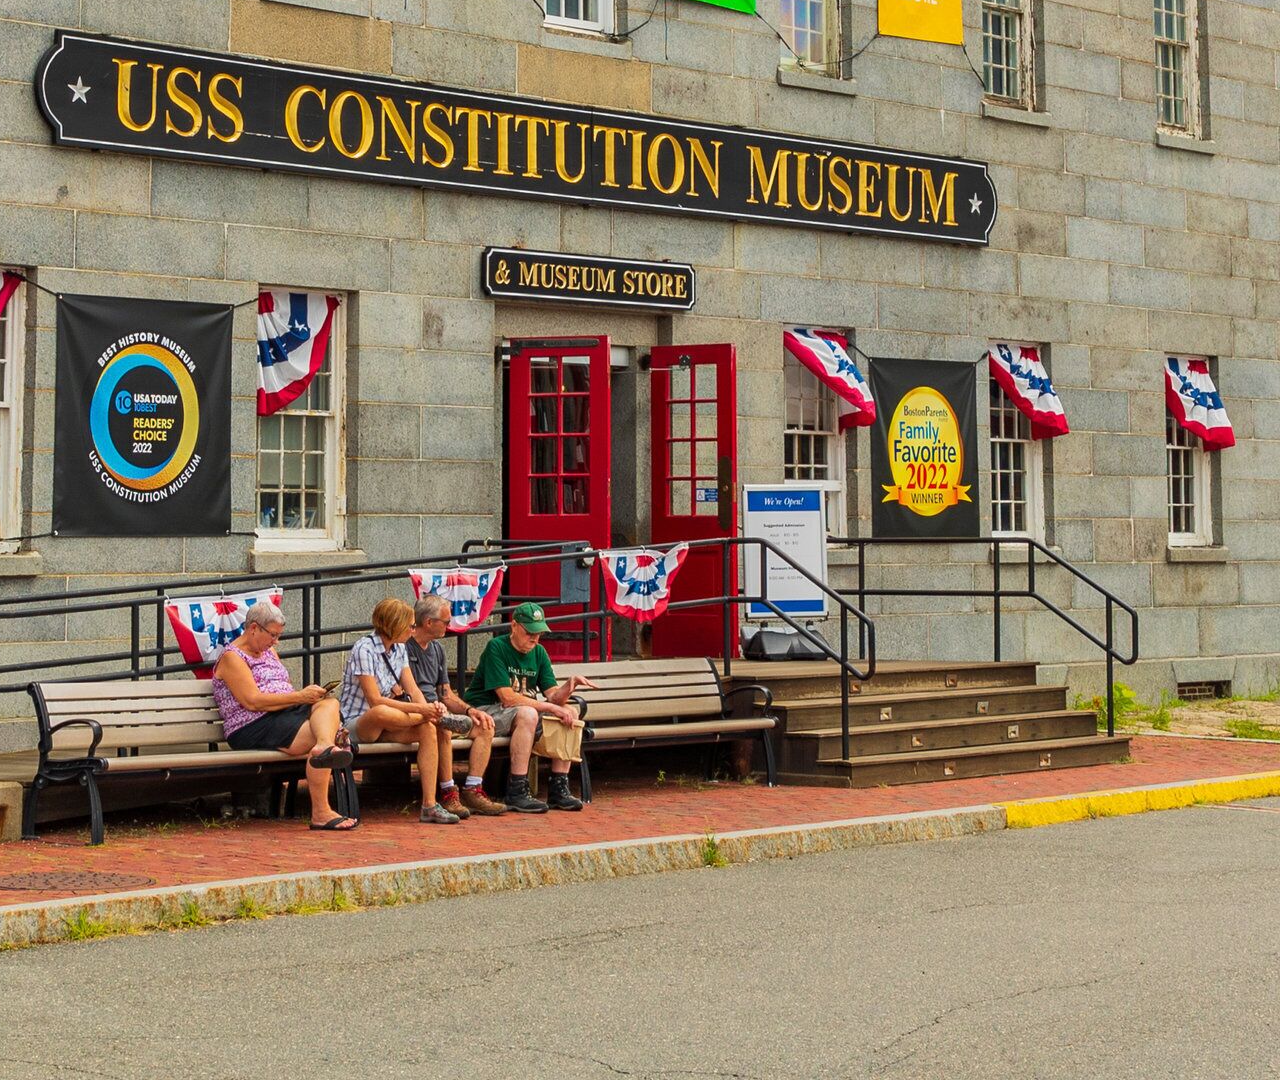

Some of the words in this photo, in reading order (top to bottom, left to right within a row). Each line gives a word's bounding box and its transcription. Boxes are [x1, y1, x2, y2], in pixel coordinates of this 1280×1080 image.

[111, 58, 245, 143] USS
[284, 85, 724, 199] CONSTITUTION
[746, 145, 959, 226] MUSEUM
[495, 259, 511, 285] &
[518, 261, 616, 293] MUSEUM
[622, 270, 688, 299] STORE
[97, 343, 118, 367] BEST
[118, 332, 160, 348] HISTORY
[160, 336, 196, 373] MUSEUM
[134, 403, 157, 412] 10BEST
[133, 430, 167, 441] CHOICE
[899, 421, 939, 444] Family
[132, 442, 152, 453] 2022
[894, 439, 956, 463] Favorite
[88, 450, 103, 473] USS
[101, 472, 168, 503] CONSTITUTION
[169, 454, 202, 495] MUSEUM
[906, 463, 949, 489] 2022
[784, 497, 804, 508] Open!
[910, 493, 944, 504] WINNER
